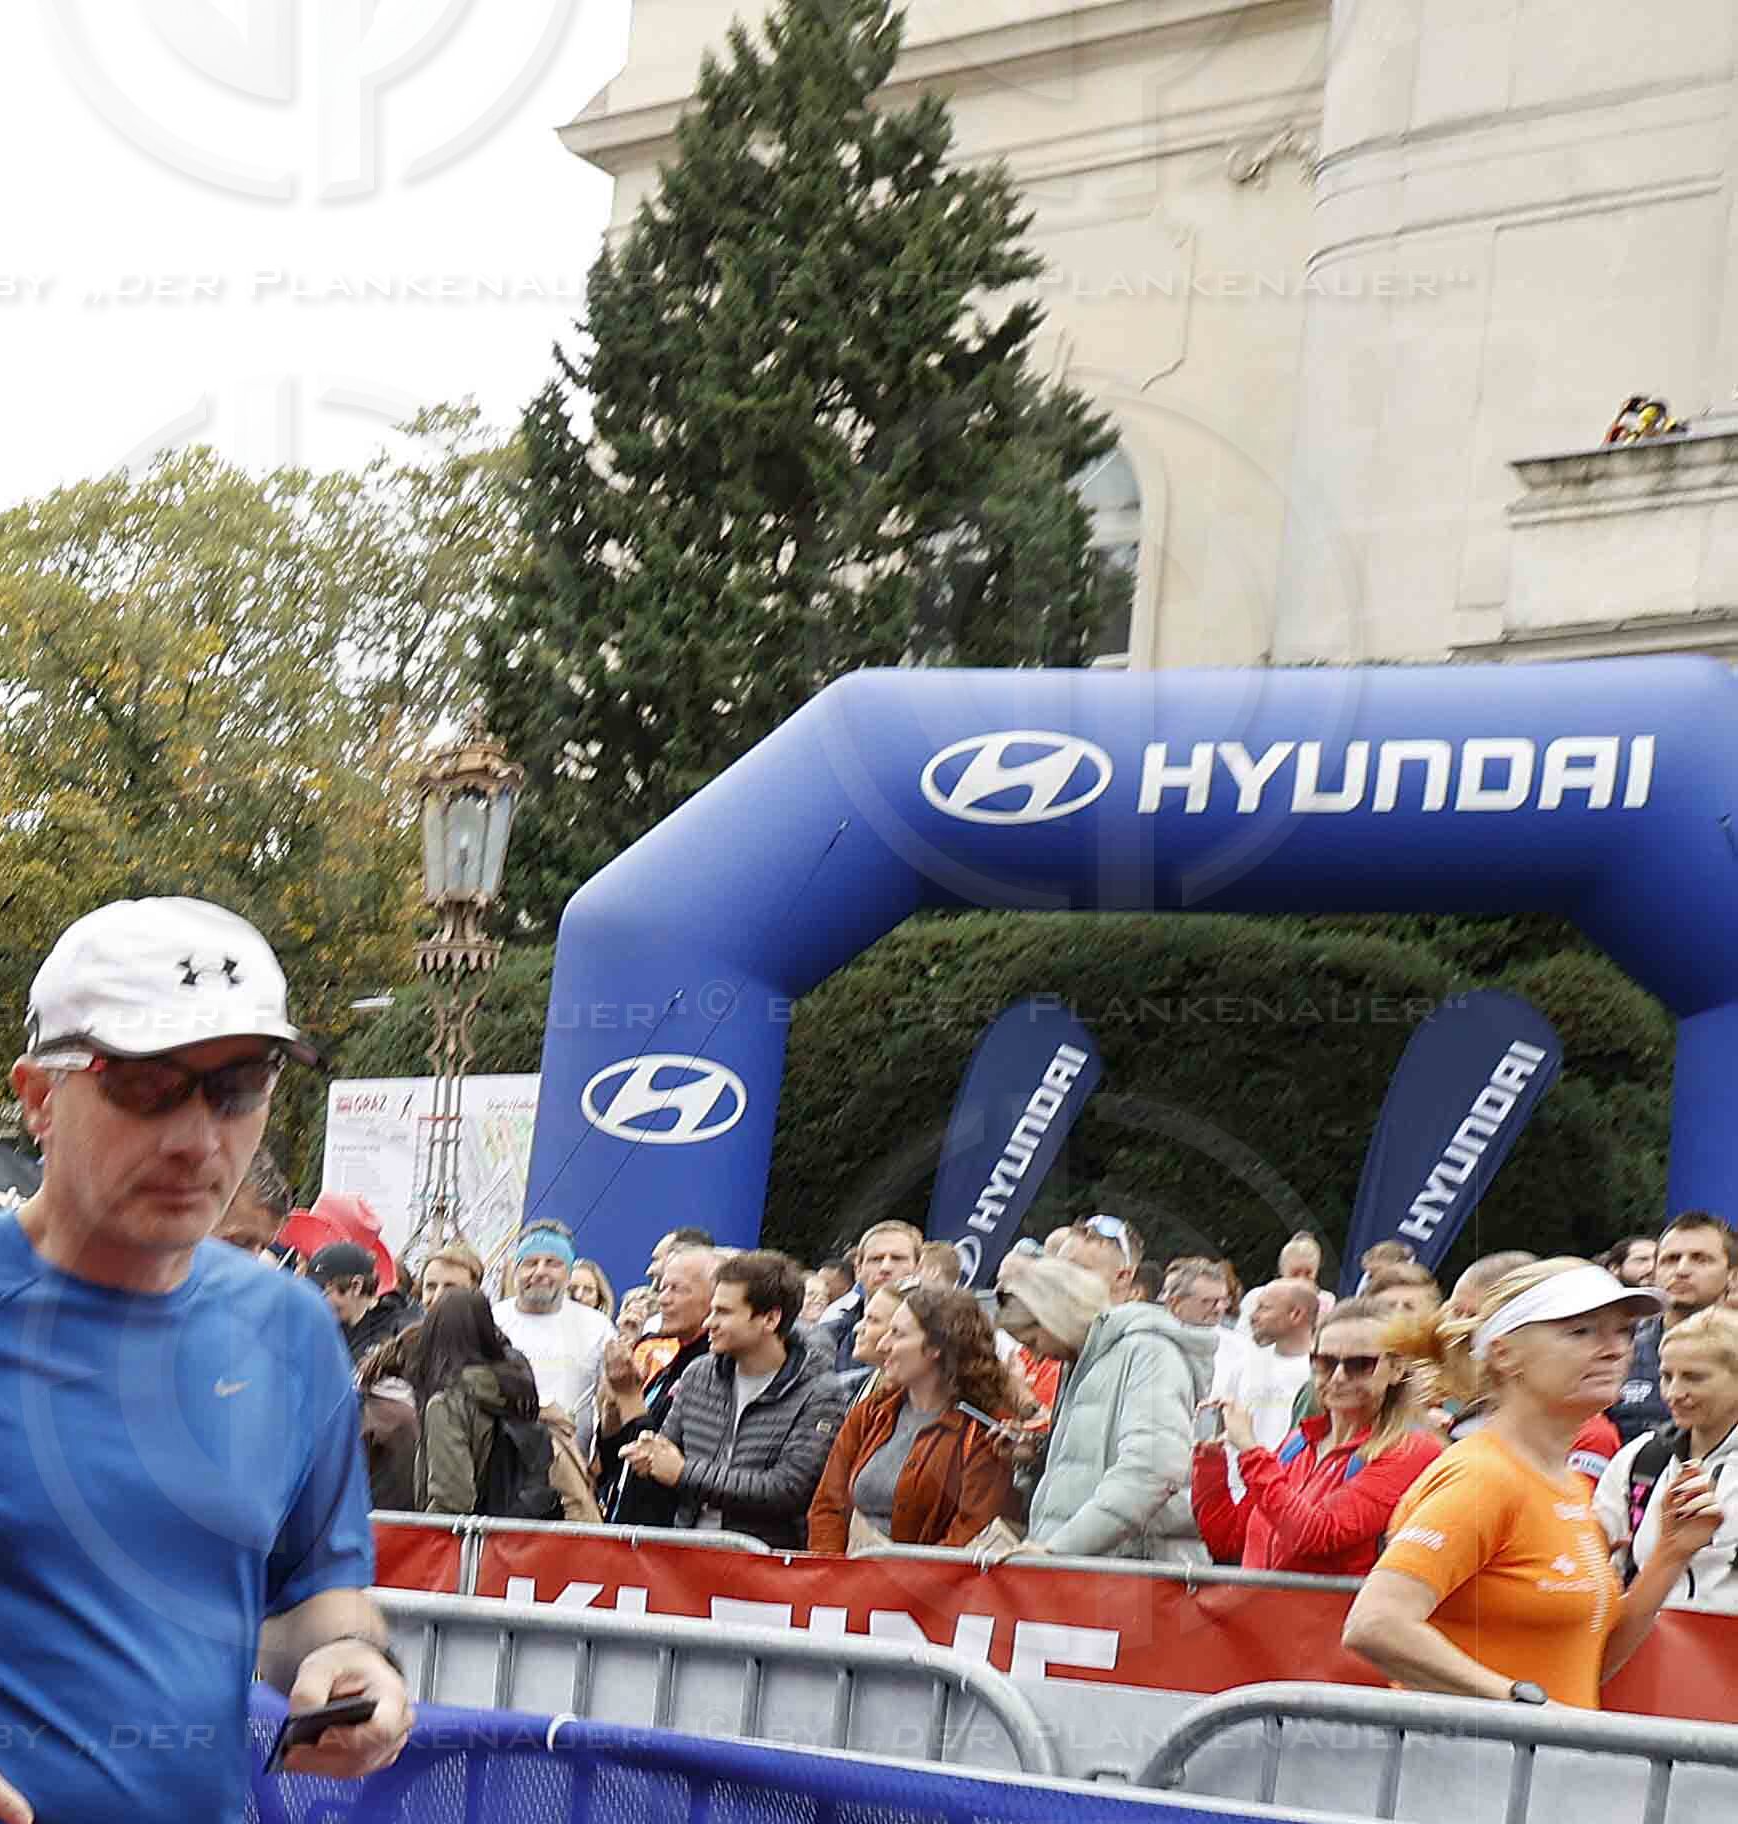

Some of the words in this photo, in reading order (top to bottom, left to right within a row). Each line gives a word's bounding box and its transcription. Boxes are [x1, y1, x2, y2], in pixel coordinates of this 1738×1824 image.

[1137, 736, 1656, 814] HYUNDAI
[967, 1043, 1091, 1236] HYUNDAI
[1397, 1038, 1549, 1243] HYUNDAI
